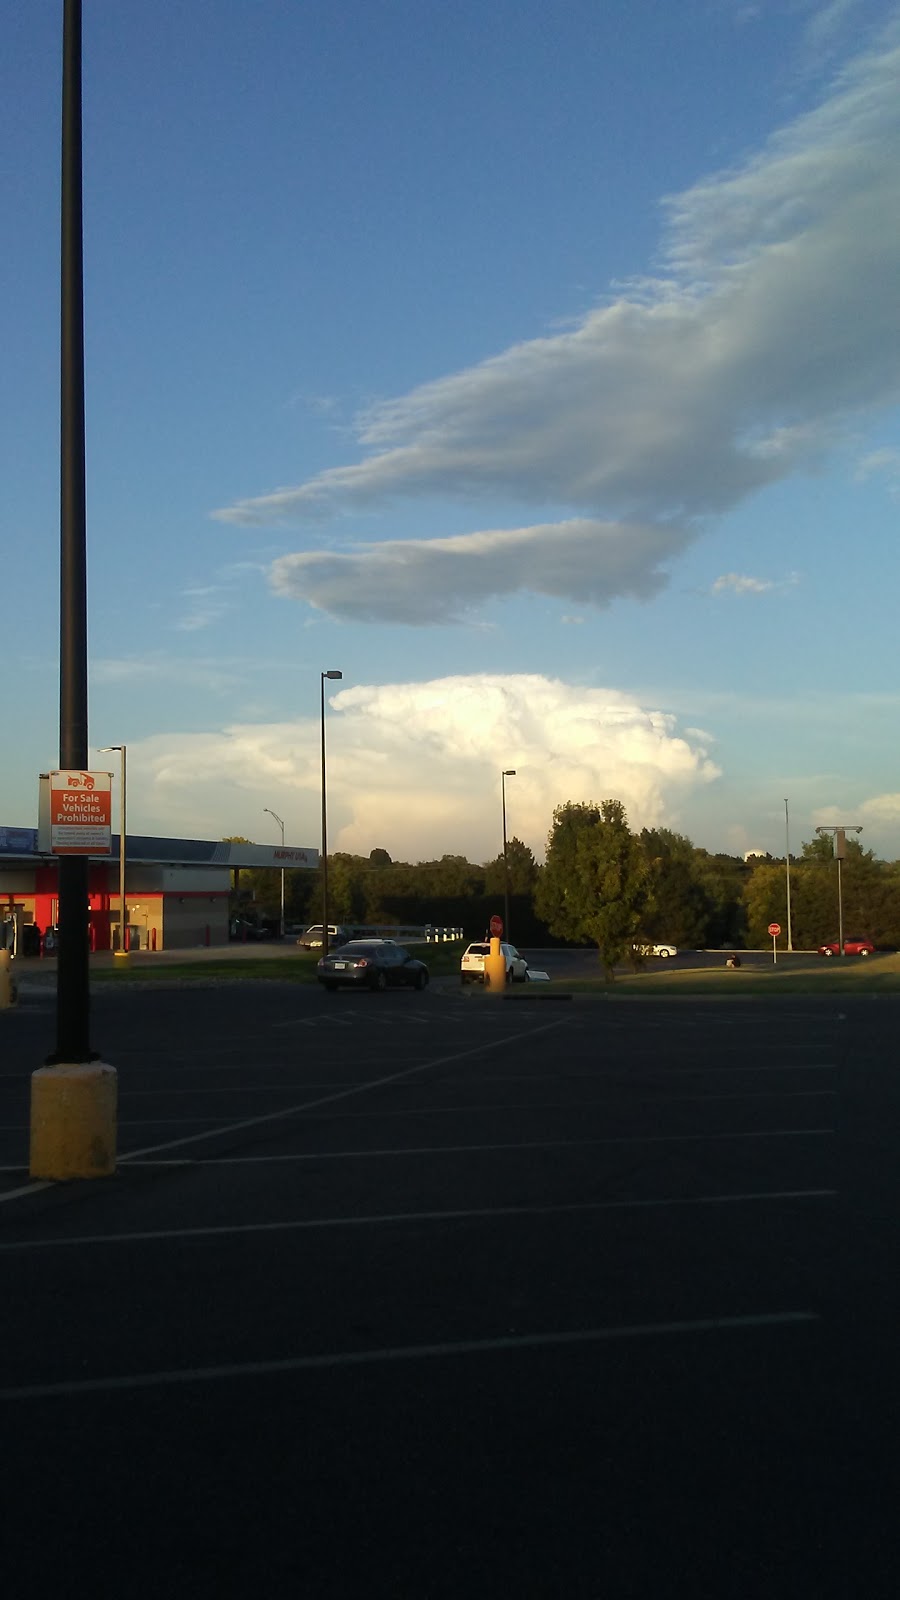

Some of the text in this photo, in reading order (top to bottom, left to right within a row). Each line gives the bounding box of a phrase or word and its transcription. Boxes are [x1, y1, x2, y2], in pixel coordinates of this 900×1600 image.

[63, 794, 99, 803] For Sale
[63, 804, 101, 813] Vehicles
[57, 814, 106, 823] Prohibited
